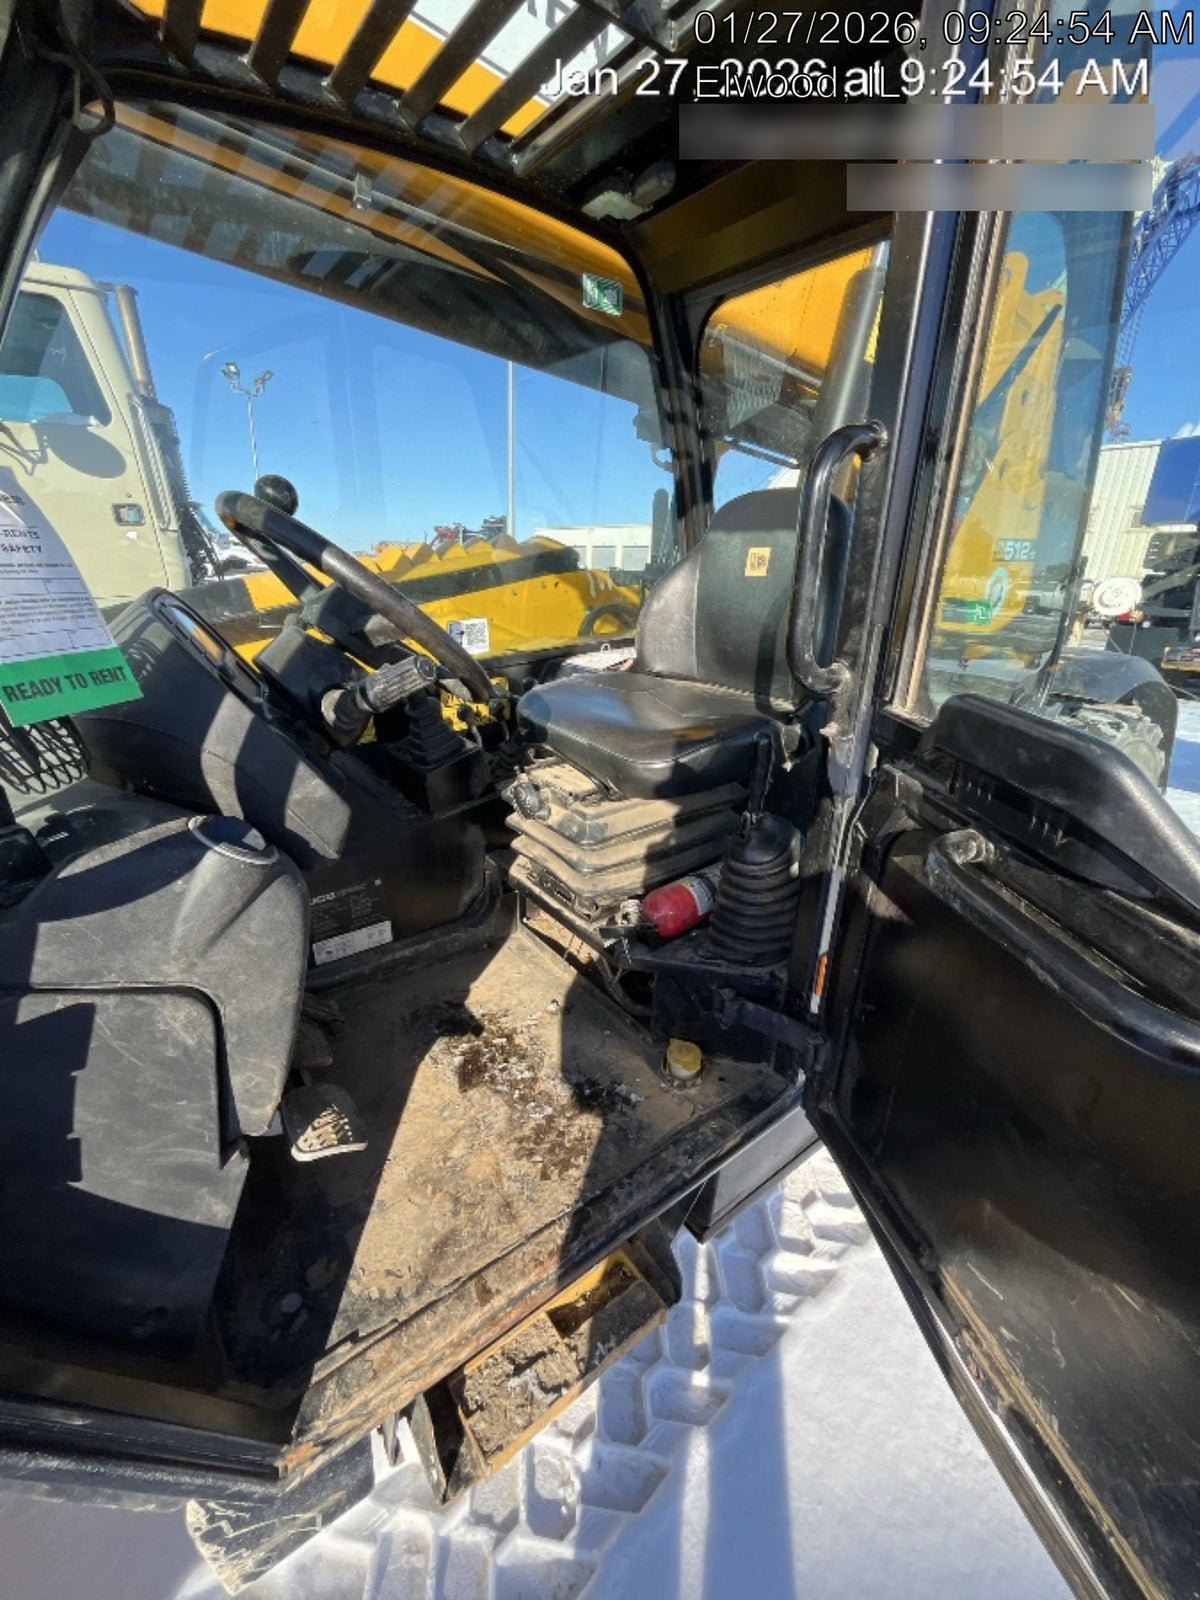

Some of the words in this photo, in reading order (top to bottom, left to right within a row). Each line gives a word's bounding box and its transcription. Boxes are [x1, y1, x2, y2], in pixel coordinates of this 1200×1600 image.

[2, 676, 64, 703] READY
[64, 673, 88, 691] TO
[88, 666, 127, 687] RENT
